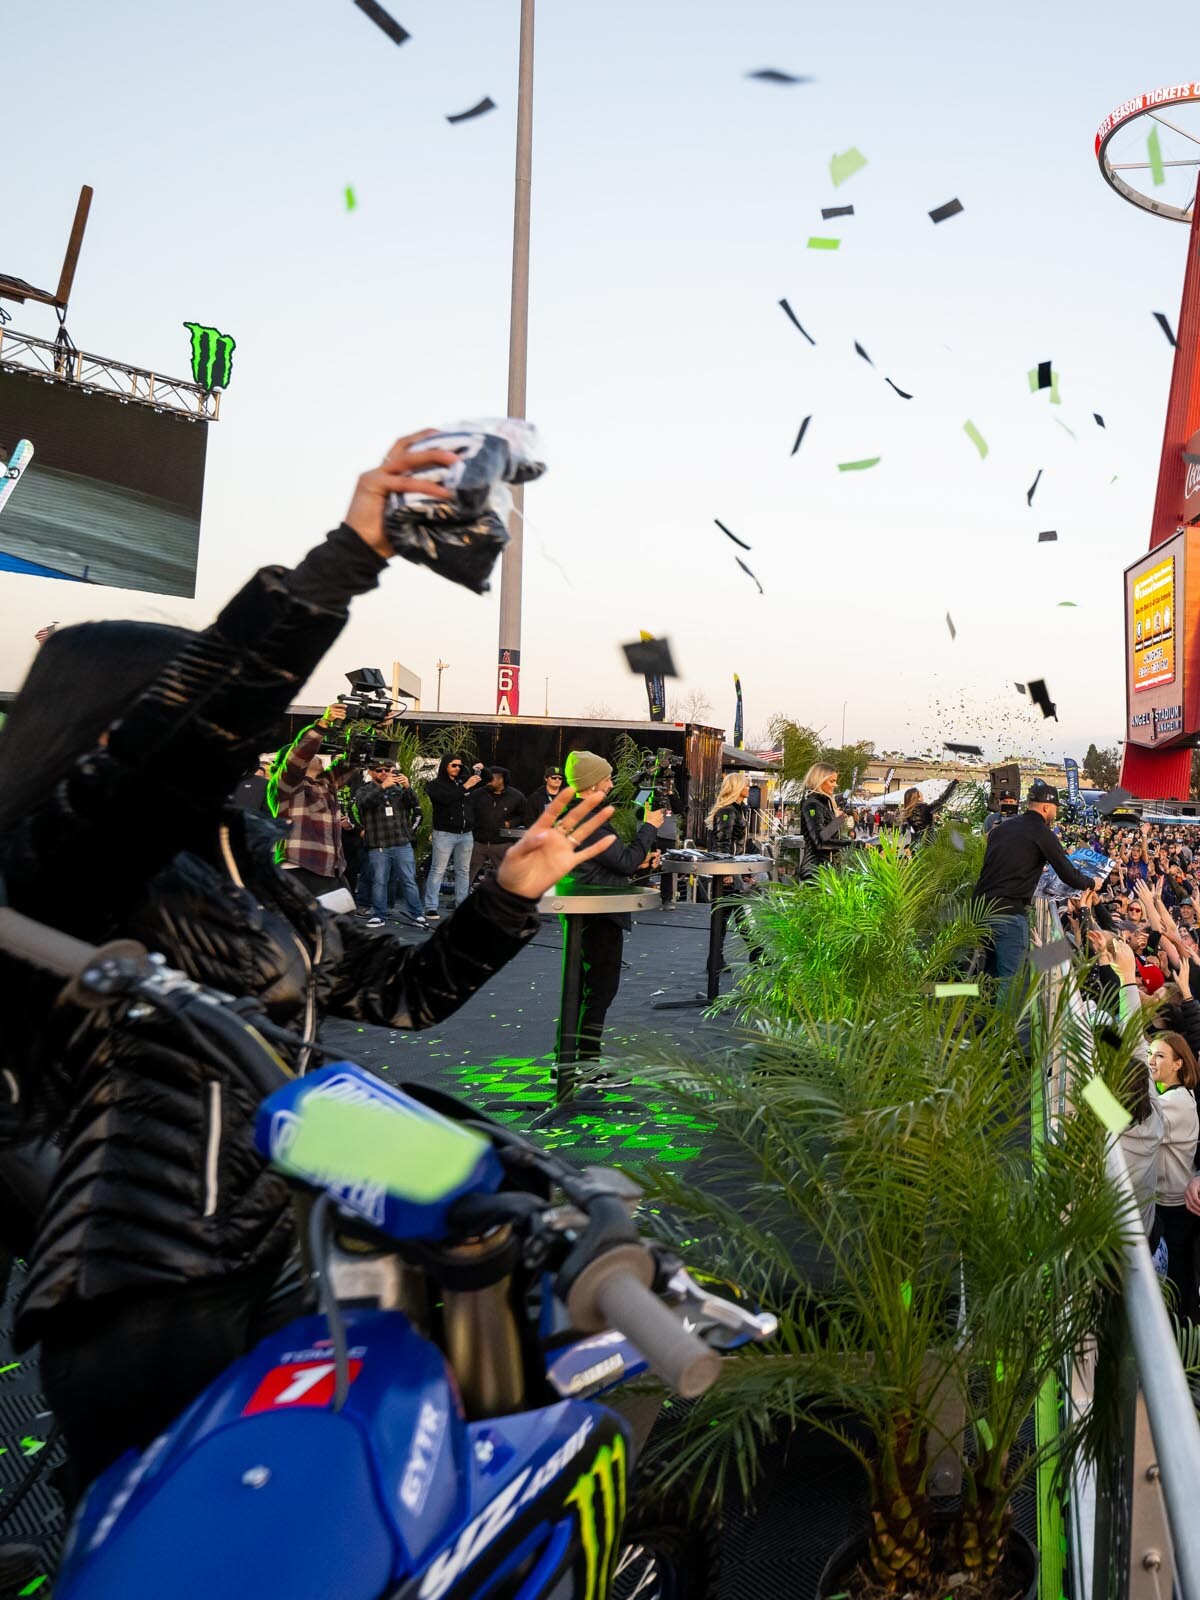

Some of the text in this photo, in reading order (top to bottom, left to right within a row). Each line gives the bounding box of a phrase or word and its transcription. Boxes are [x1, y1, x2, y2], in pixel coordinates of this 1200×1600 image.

[1111, 96, 1143, 125] SEASON
[1145, 83, 1190, 106] TICKETS
[499, 669, 513, 691] 6
[498, 695, 512, 716] A
[1131, 706, 1180, 727] ANGEL STADIUM
[280, 1346, 368, 1364] TOMC
[274, 1363, 337, 1404] 1
[400, 1401, 439, 1509] GYTR
